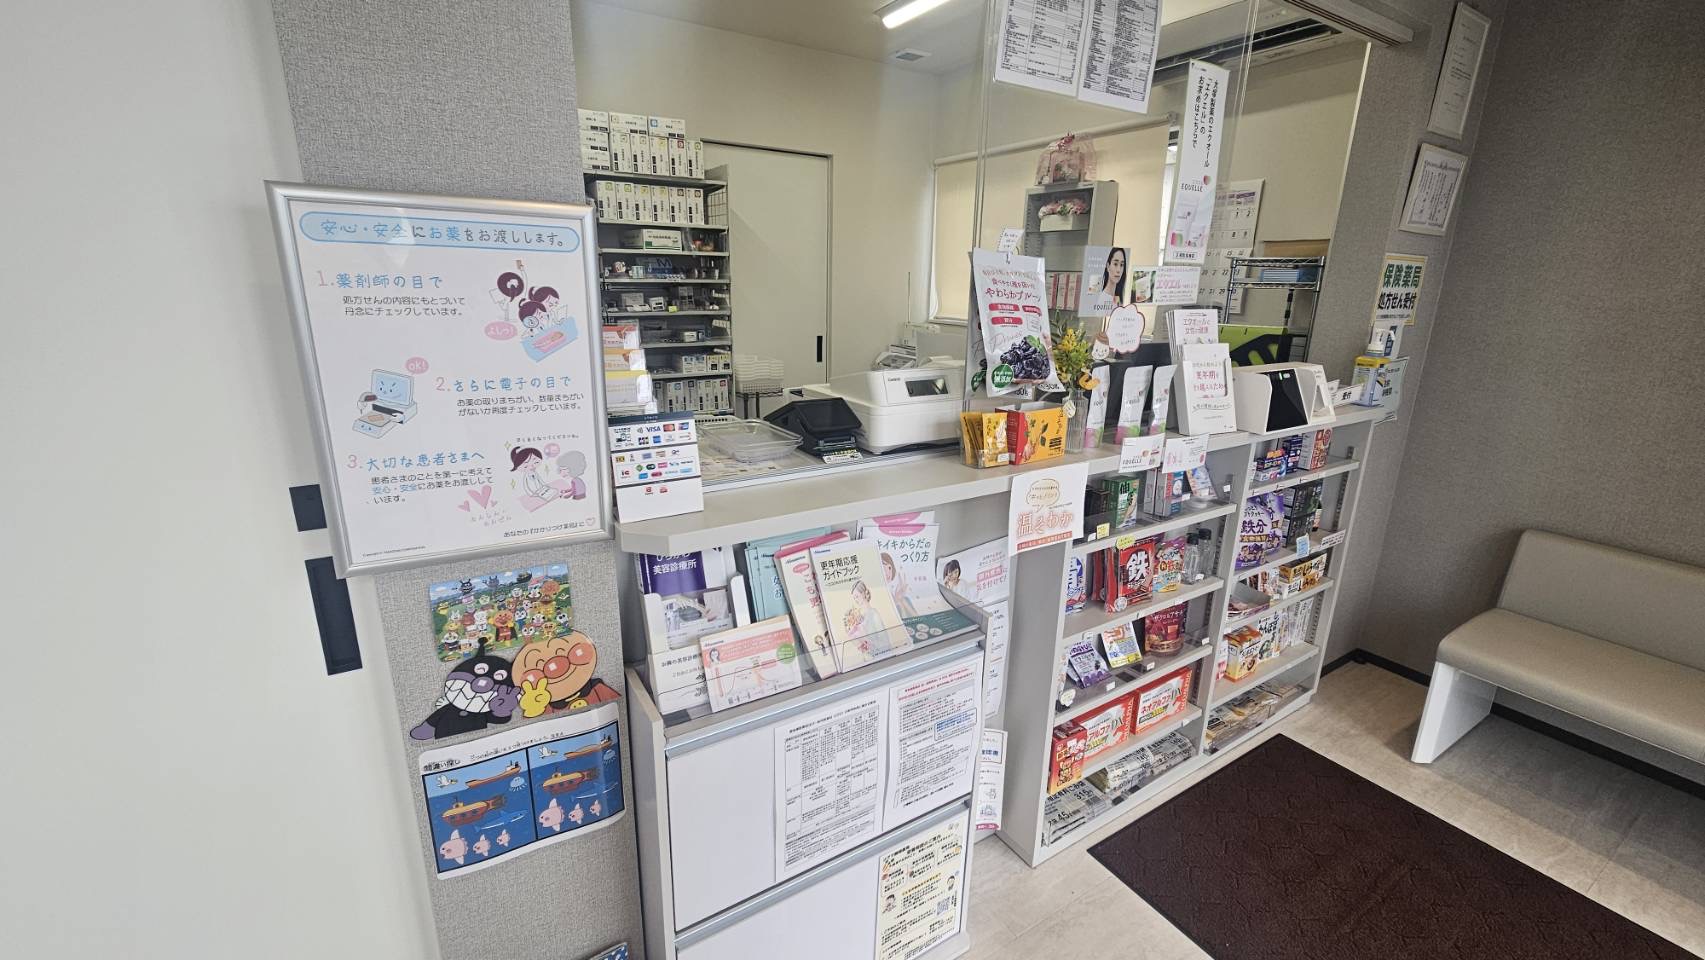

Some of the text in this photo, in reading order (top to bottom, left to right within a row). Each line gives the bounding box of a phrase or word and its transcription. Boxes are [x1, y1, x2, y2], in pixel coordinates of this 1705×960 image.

[320, 219, 565, 248] 安心・安全にお薬をお渡しします。
[1383, 263, 1422, 288] 保険薬局
[343, 295, 465, 305] 処方せんの内容にもとづいて
[1377, 292, 1417, 310] 処方せん受付
[345, 307, 463, 316] 丹念にチェックしています。
[646, 425, 661, 433] VISA
[371, 467, 493, 485] 患者さまのことを第一に考えて
[373, 495, 406, 504] います。
[1241, 519, 1268, 534] 鉄分
[820, 554, 859, 571] 更年期応援
[900, 551, 929, 563] つくり方
[653, 559, 697, 575] 美容診療所
[1126, 550, 1149, 582] 鉄
